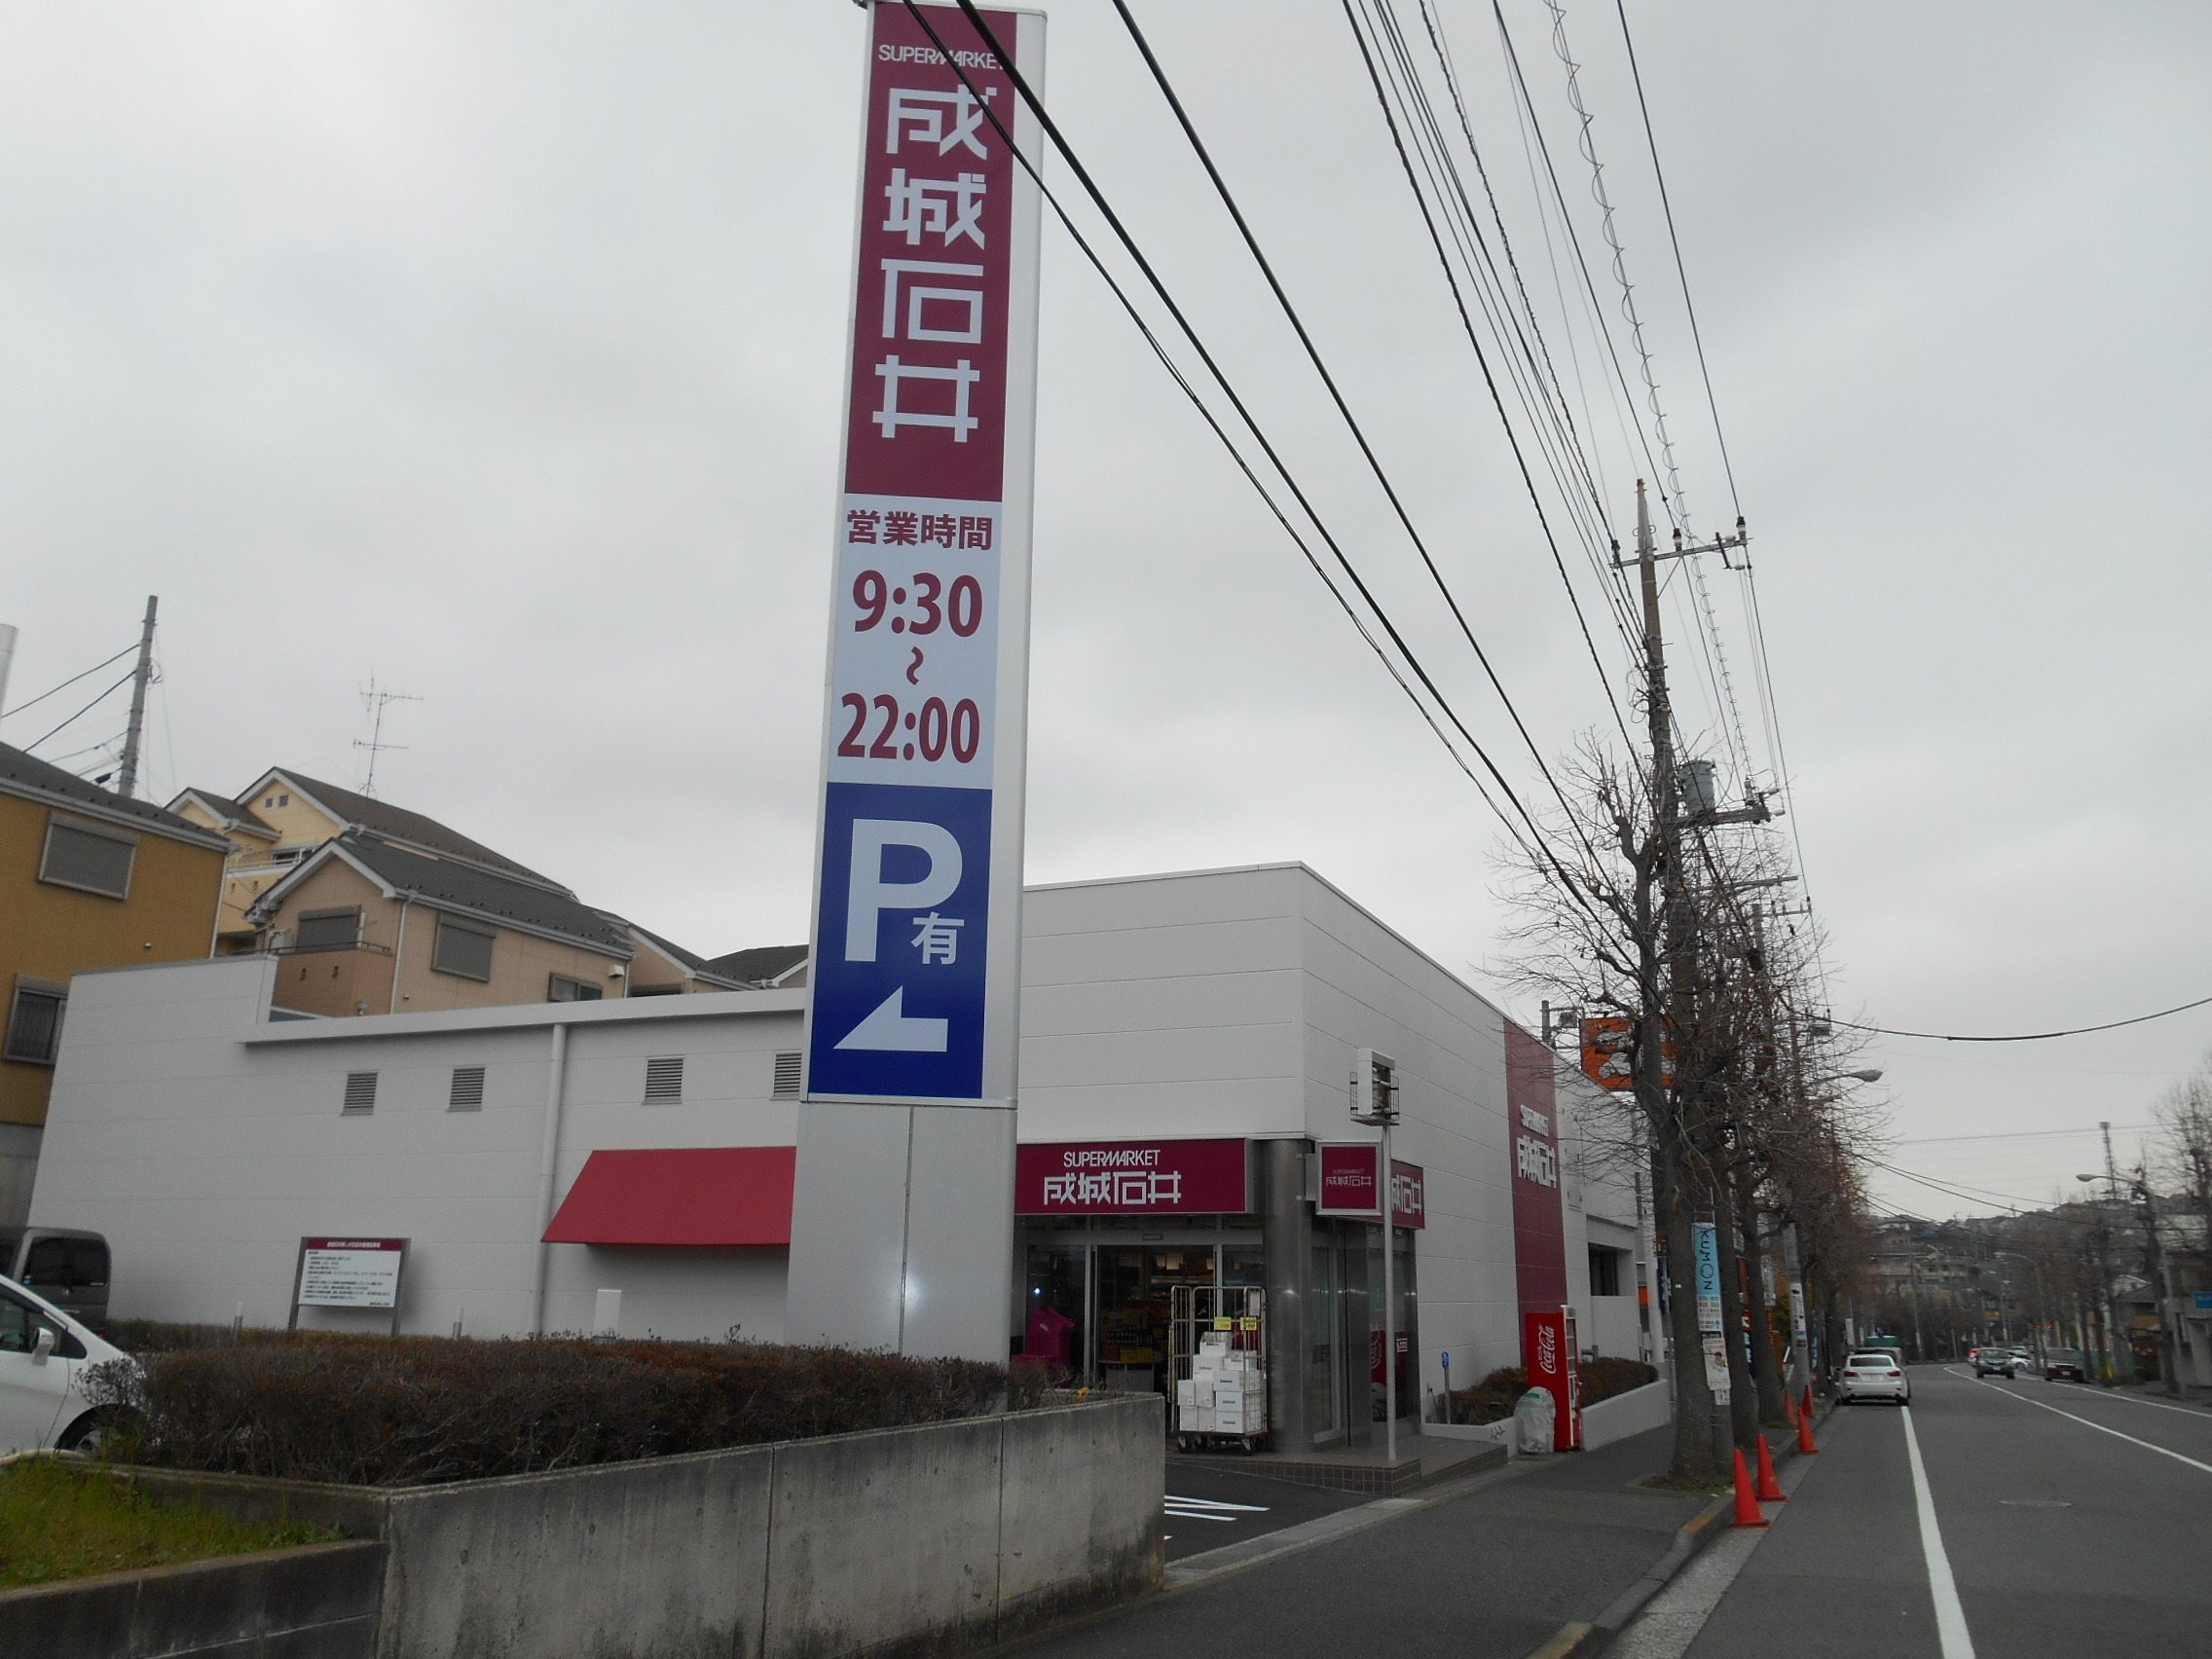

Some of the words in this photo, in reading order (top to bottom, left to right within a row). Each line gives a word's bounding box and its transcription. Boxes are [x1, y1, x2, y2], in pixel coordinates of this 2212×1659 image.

[878, 44, 1004, 70] SUPERMARKE
[872, 84, 997, 443] 成城石井
[847, 509, 993, 551] 営業時間
[853, 570, 983, 638] 9:30
[837, 693, 980, 764] 22:00
[1063, 1149, 1161, 1167] SUPERMARKET
[1044, 1170, 1182, 1205] 成城石井
[1325, 1175, 1372, 1187] 成城石井
[1699, 1230, 1714, 1290] KUMON
